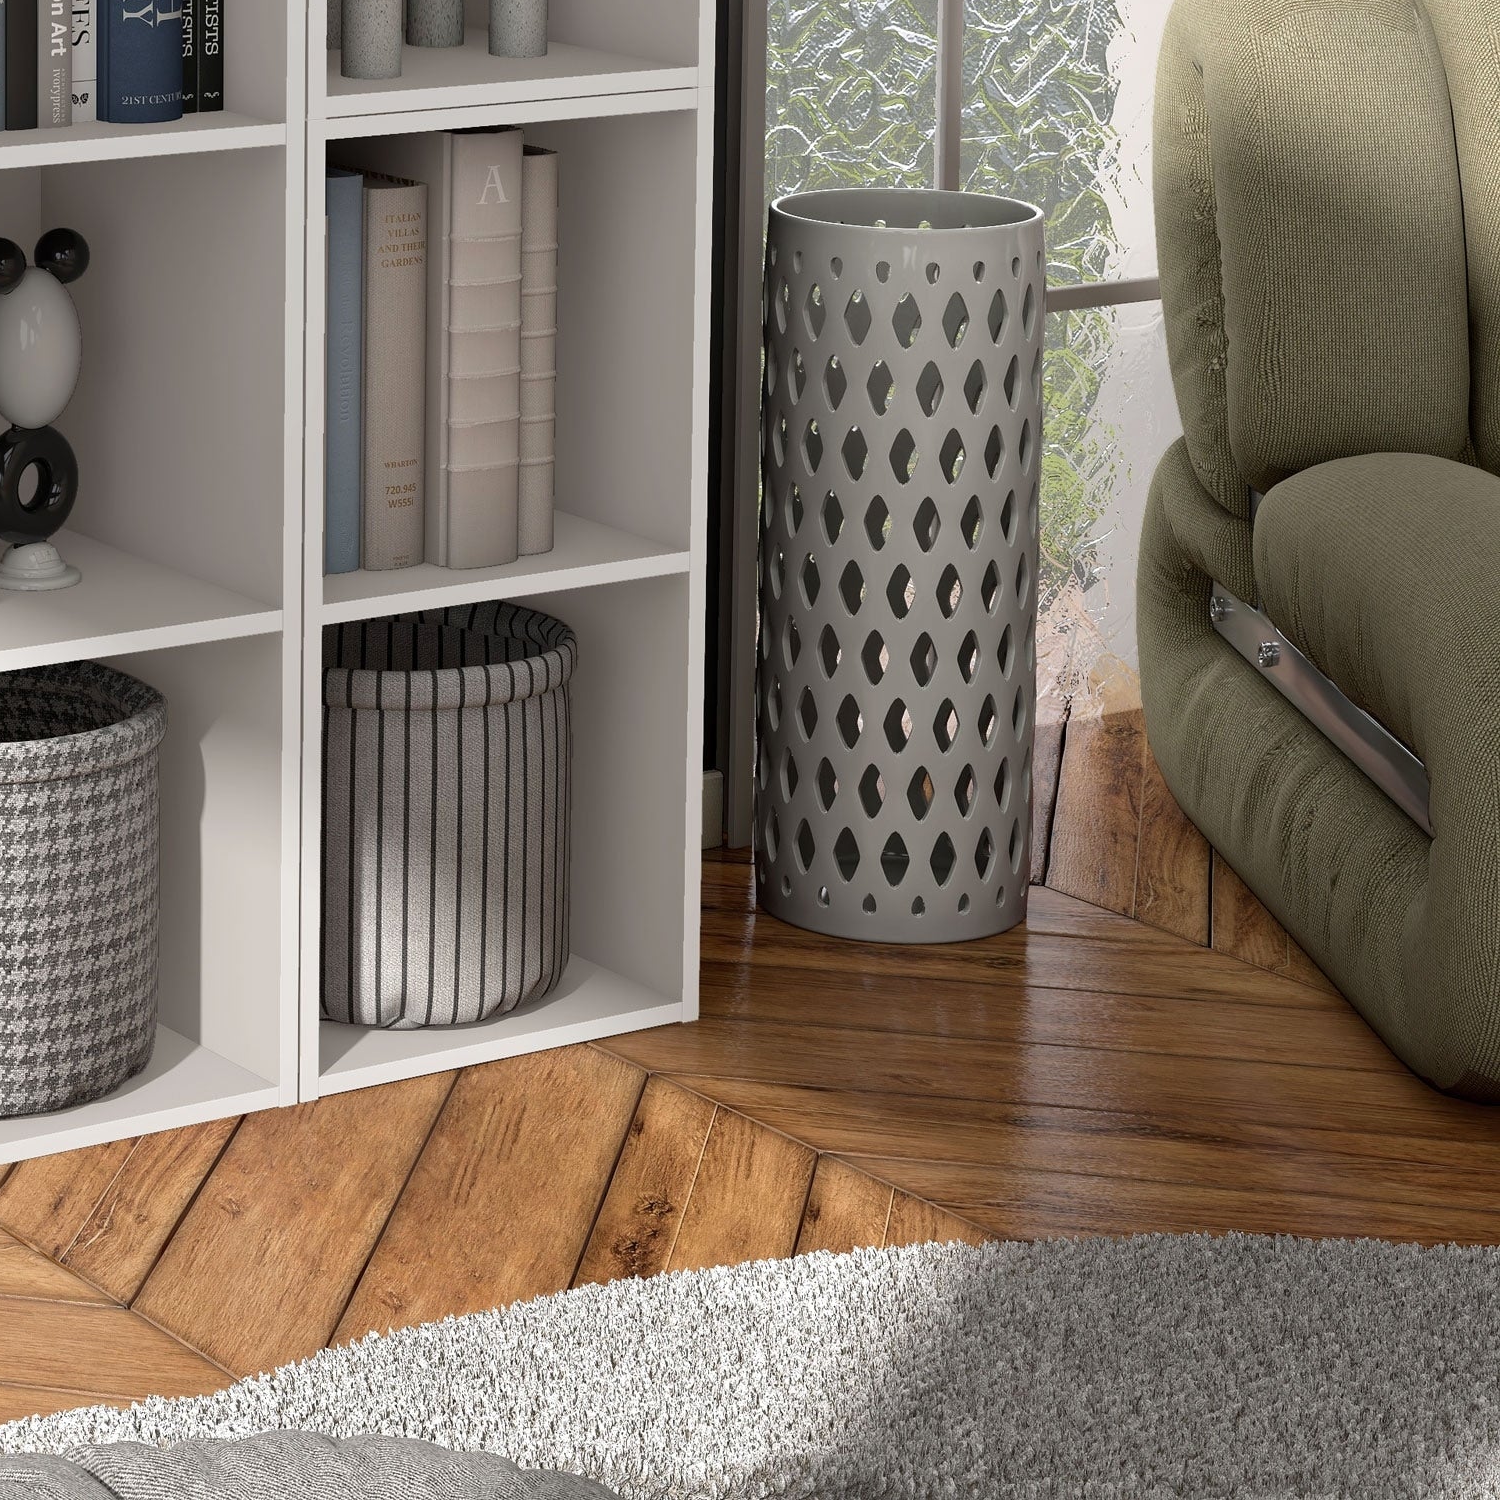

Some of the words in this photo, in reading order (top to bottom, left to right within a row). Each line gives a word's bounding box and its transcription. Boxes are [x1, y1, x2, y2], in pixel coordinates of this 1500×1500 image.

[51, 23, 68, 57] Art
[50, 69, 61, 124] ivorypress
[122, 95, 149, 105] 21ST
[476, 164, 511, 205] A
[384, 212, 422, 224] ITALIAN
[387, 227, 420, 238] VILLAS
[377, 244, 399, 254] AND
[401, 241, 427, 252] THEIR
[381, 256, 423, 268] GARDENS
[384, 459, 418, 469] WHARTON
[385, 483, 417, 495] 720.945
